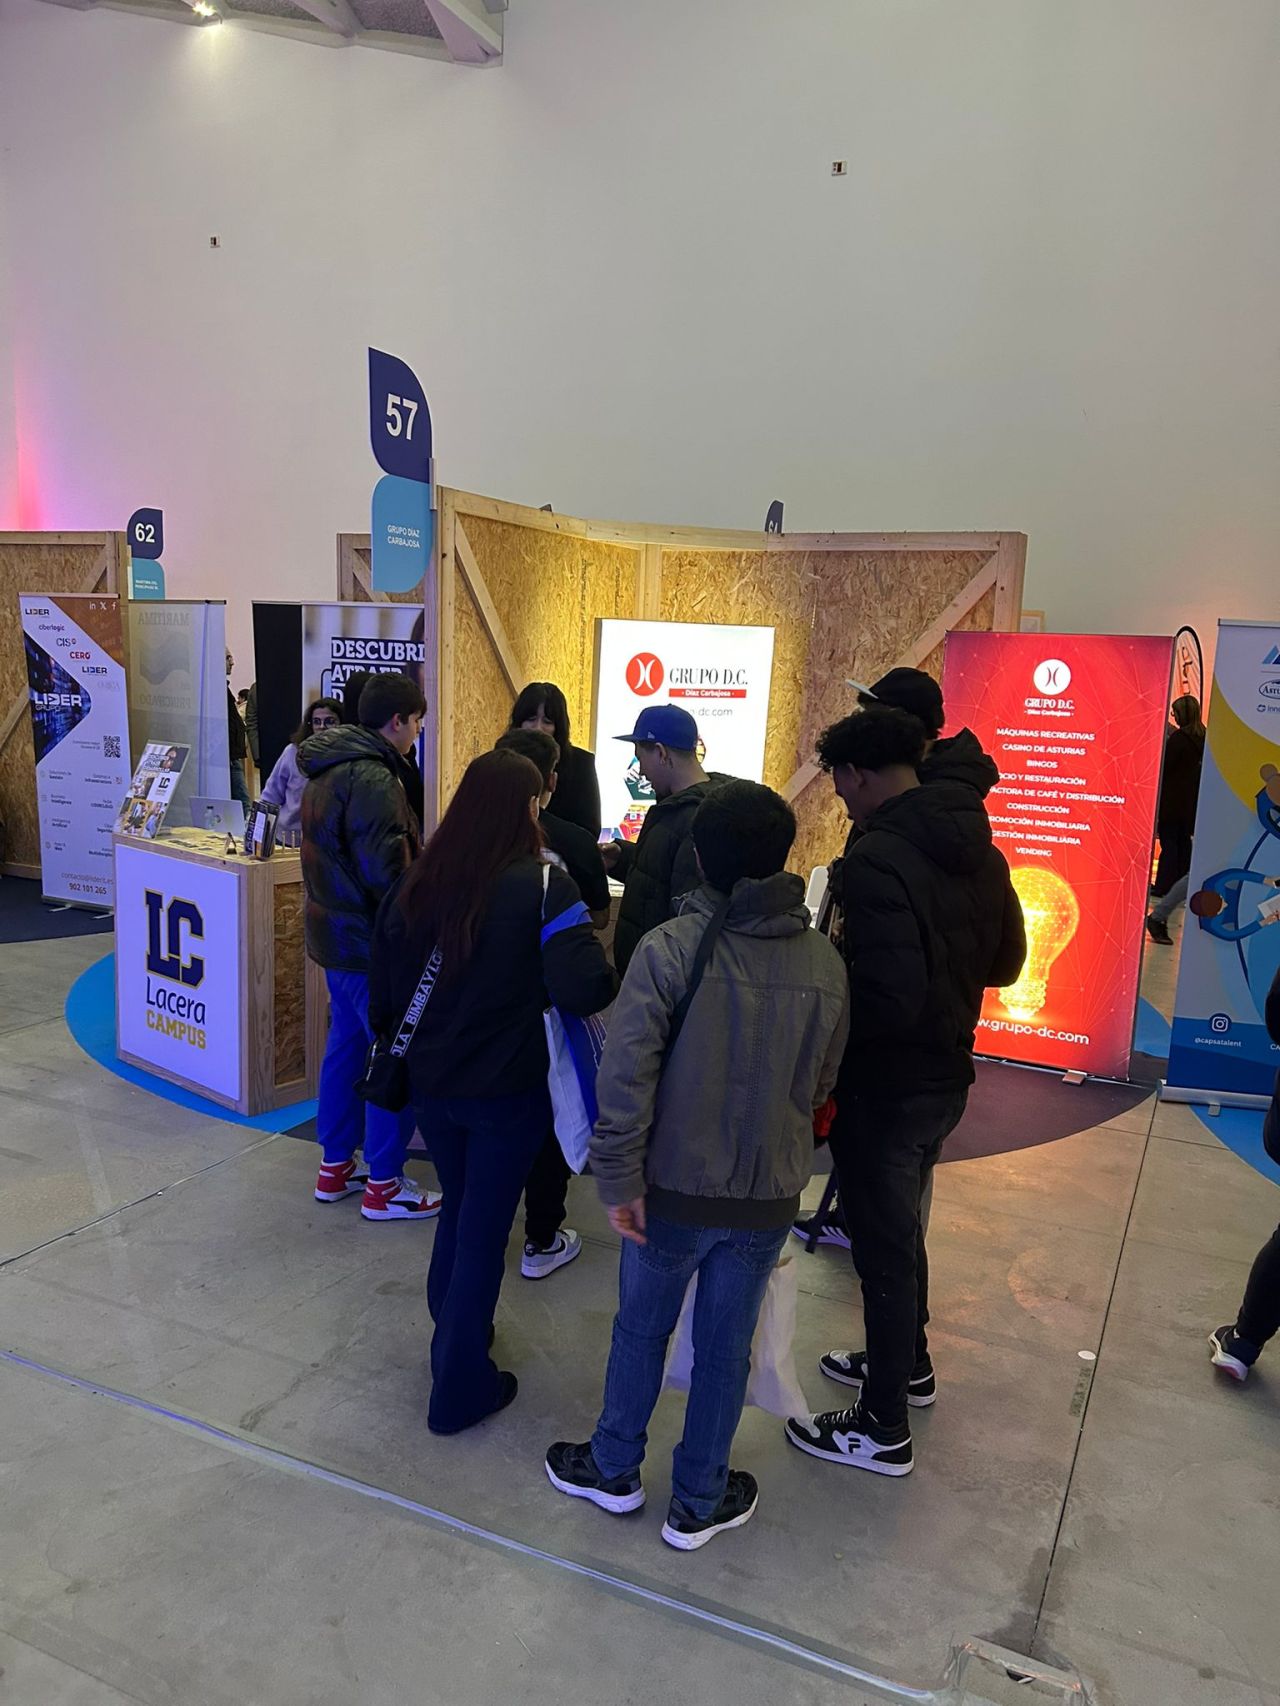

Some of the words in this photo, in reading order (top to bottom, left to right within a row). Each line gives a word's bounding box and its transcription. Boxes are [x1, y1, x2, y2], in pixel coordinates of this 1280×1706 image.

[386, 393, 418, 441] 57
[135, 523, 155, 543] 62
[387, 524, 407, 536] GRUPO
[387, 536, 420, 548] CARBAJOSA
[39, 624, 65, 633] ciberlogic
[669, 668, 719, 685] GRUPO
[723, 668, 748, 686] D.C.
[1024, 698, 1057, 709] GRUPO
[996, 728, 1039, 738] MÁQUINAS
[1040, 731, 1095, 741] RECREATIVAS
[1002, 743, 1032, 752] CASINO
[1046, 746, 1086, 756] ASTURIAS
[1026, 760, 1058, 769] BINGOS
[1024, 775, 1086, 786] RESTAURACIÓN
[989, 786, 1023, 796] ACTORA
[1024, 789, 1036, 797] DE
[1036, 790, 1058, 799] CAFÉ
[1066, 792, 1125, 804] DISTRIBUCIÓN
[1006, 803, 1070, 814] CONSTRUCCIÓN
[1034, 818, 1091, 831] INMOBILIARIA
[1025, 834, 1081, 845] INMOBILIARIA
[1015, 847, 1052, 857] VENDING
[144, 888, 206, 989] LC
[146, 976, 206, 1025] Lacera
[146, 1009, 207, 1050] CAMPUS
[1194, 1037, 1242, 1048] @capsatalent
